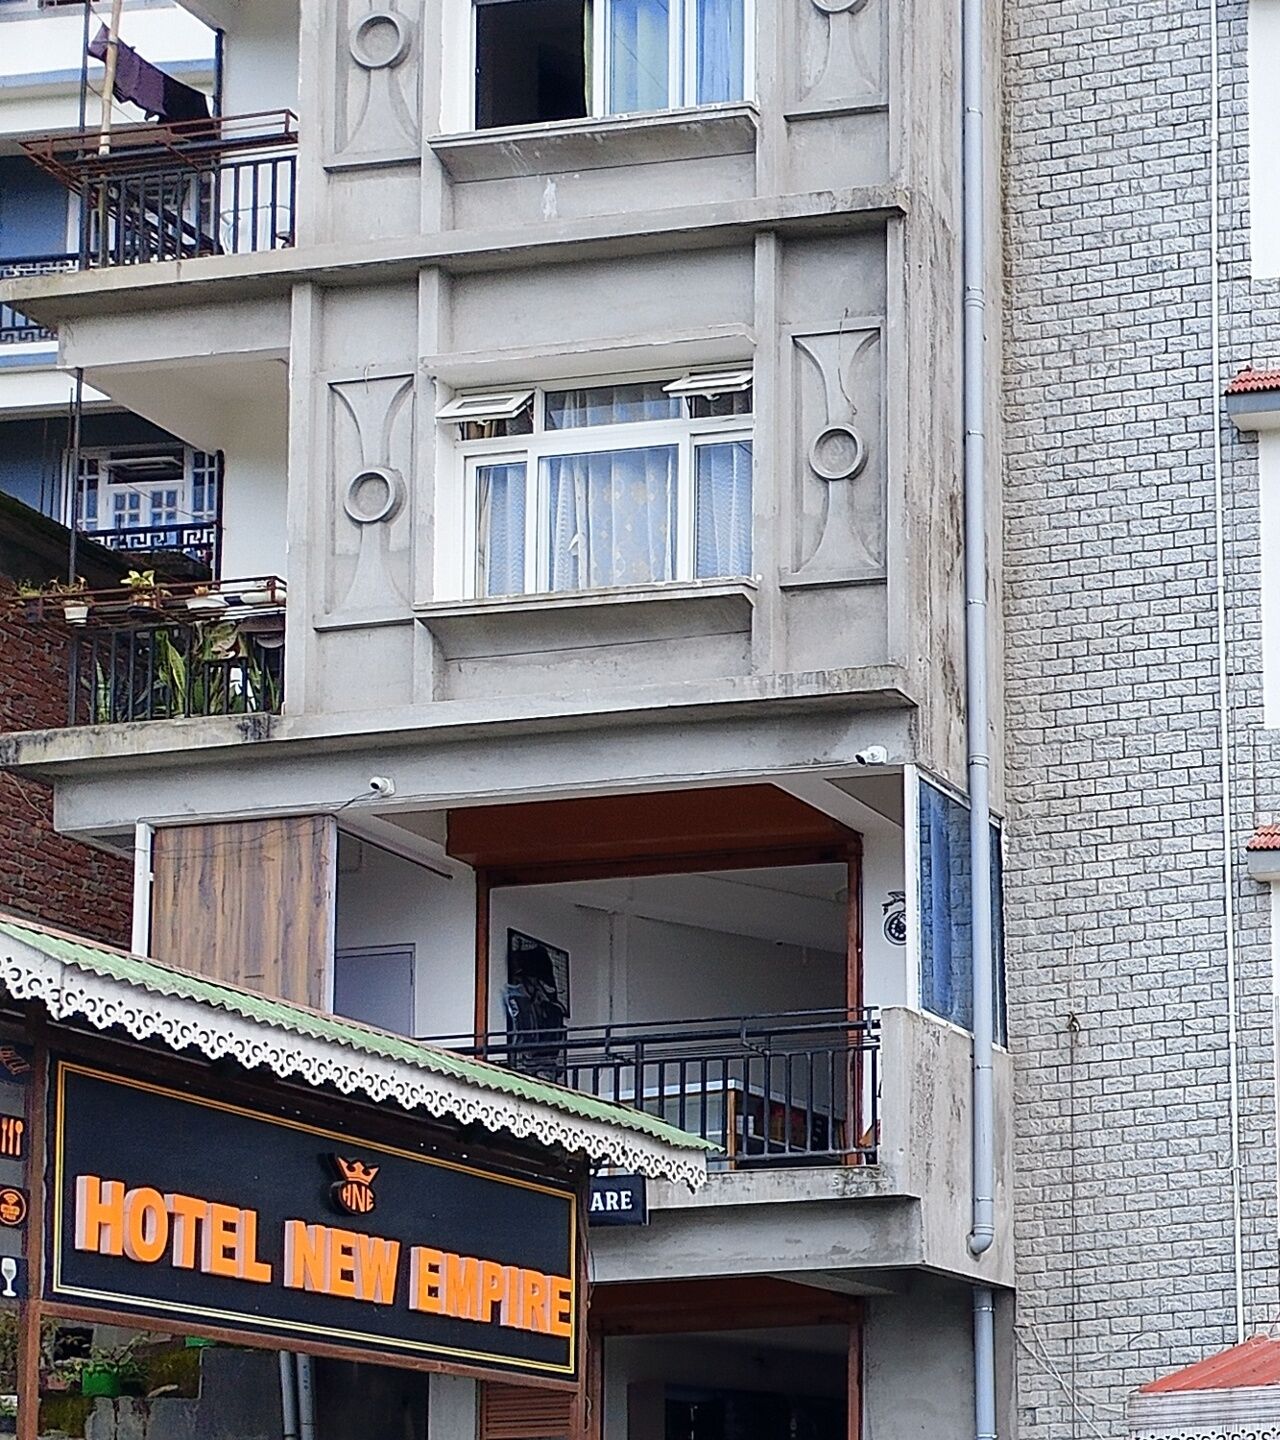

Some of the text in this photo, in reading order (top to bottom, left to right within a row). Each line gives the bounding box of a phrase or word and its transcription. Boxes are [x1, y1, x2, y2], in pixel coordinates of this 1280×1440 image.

[75, 1175, 574, 1338] HOTEL NEW EMPIRE
